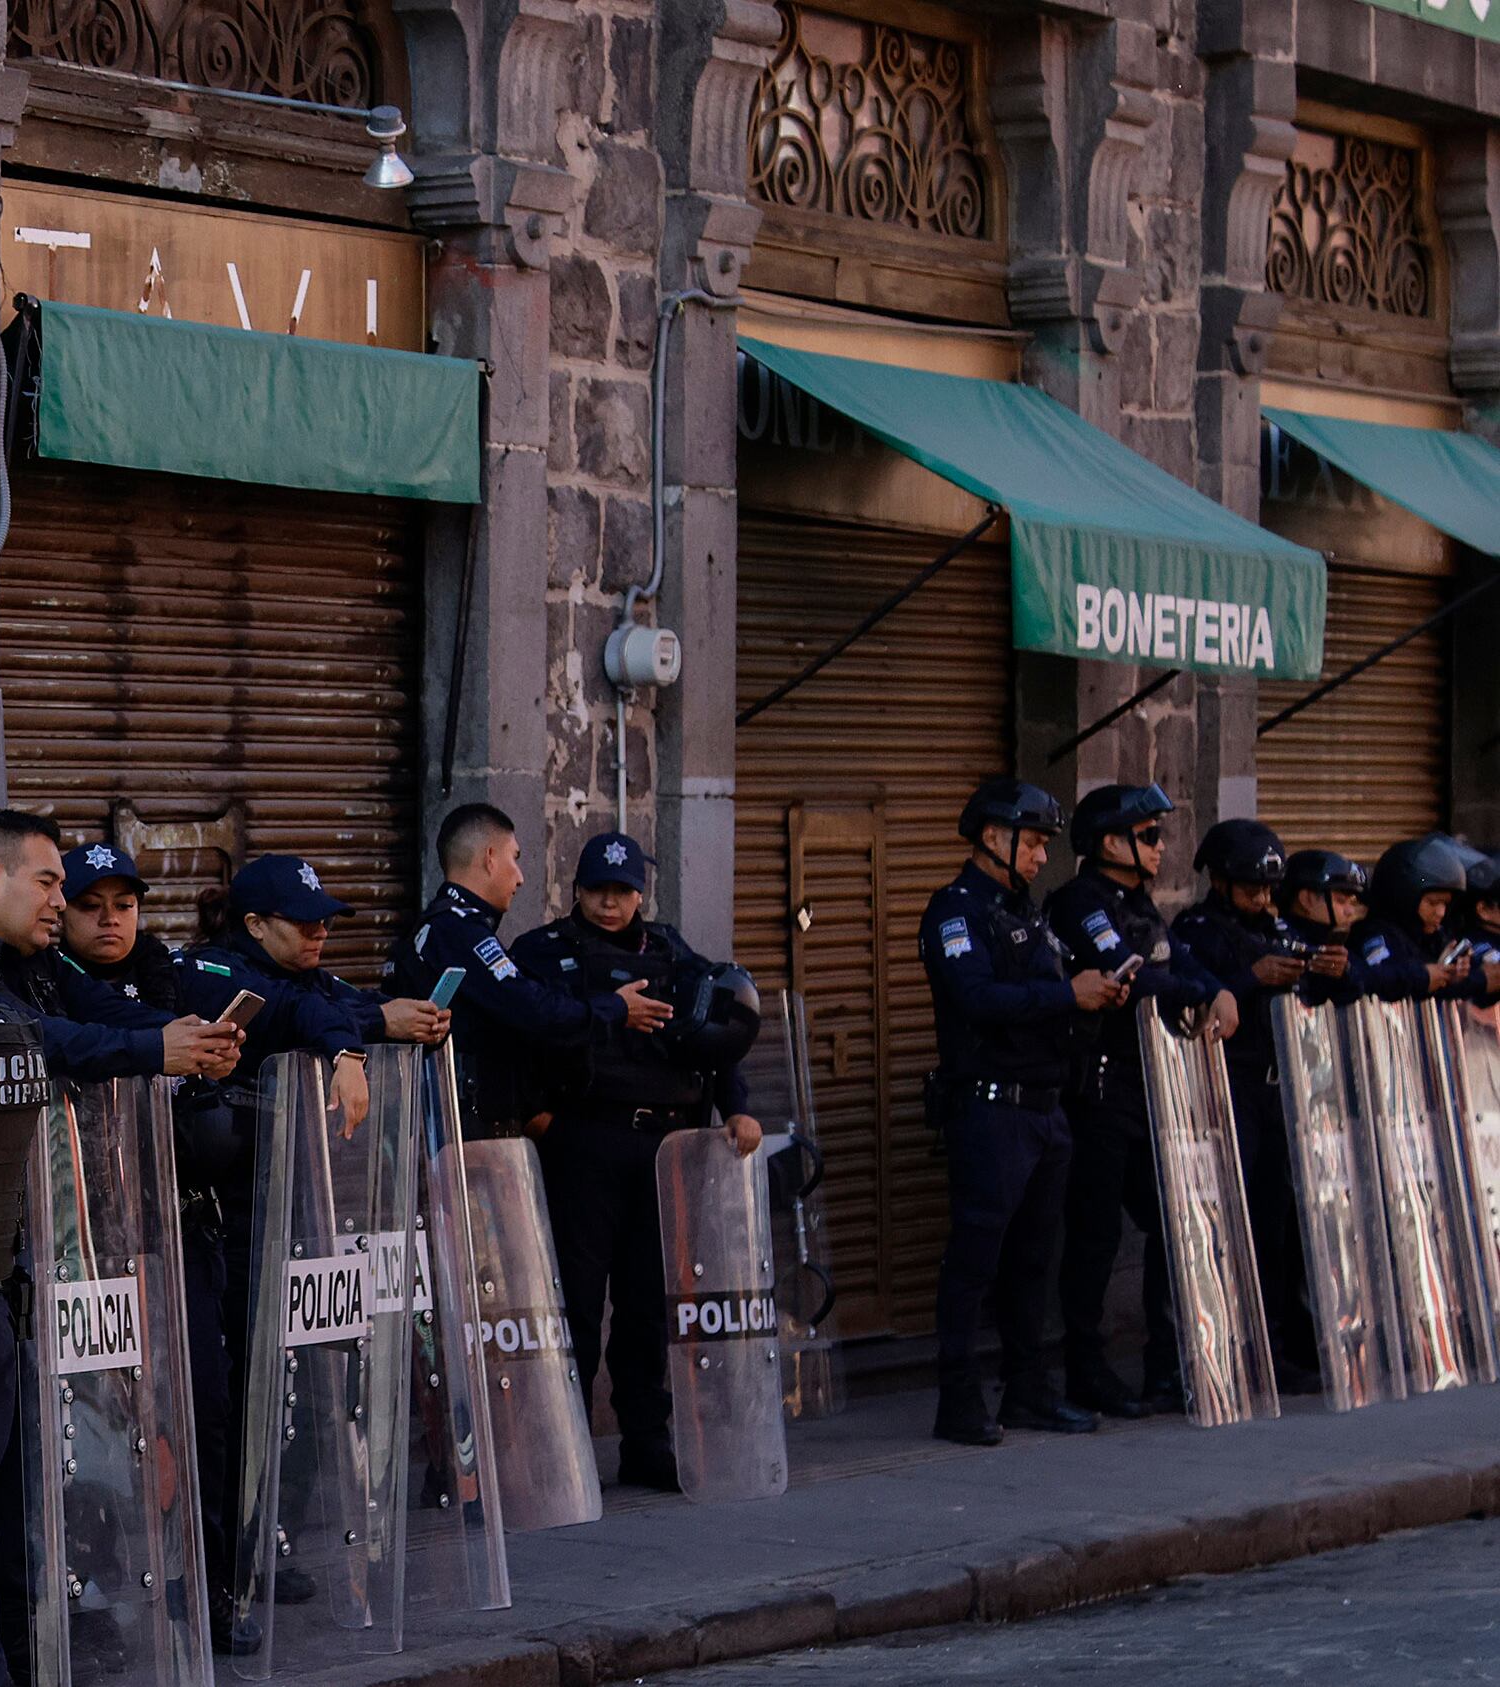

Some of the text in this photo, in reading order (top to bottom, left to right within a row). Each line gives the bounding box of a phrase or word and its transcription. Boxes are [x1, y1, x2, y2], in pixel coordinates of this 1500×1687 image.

[1076, 583, 1274, 670] BONETERIA
[57, 1293, 137, 1360] POLICIA
[288, 1267, 363, 1333] POLICIA
[677, 1298, 776, 1336] POLICIA
